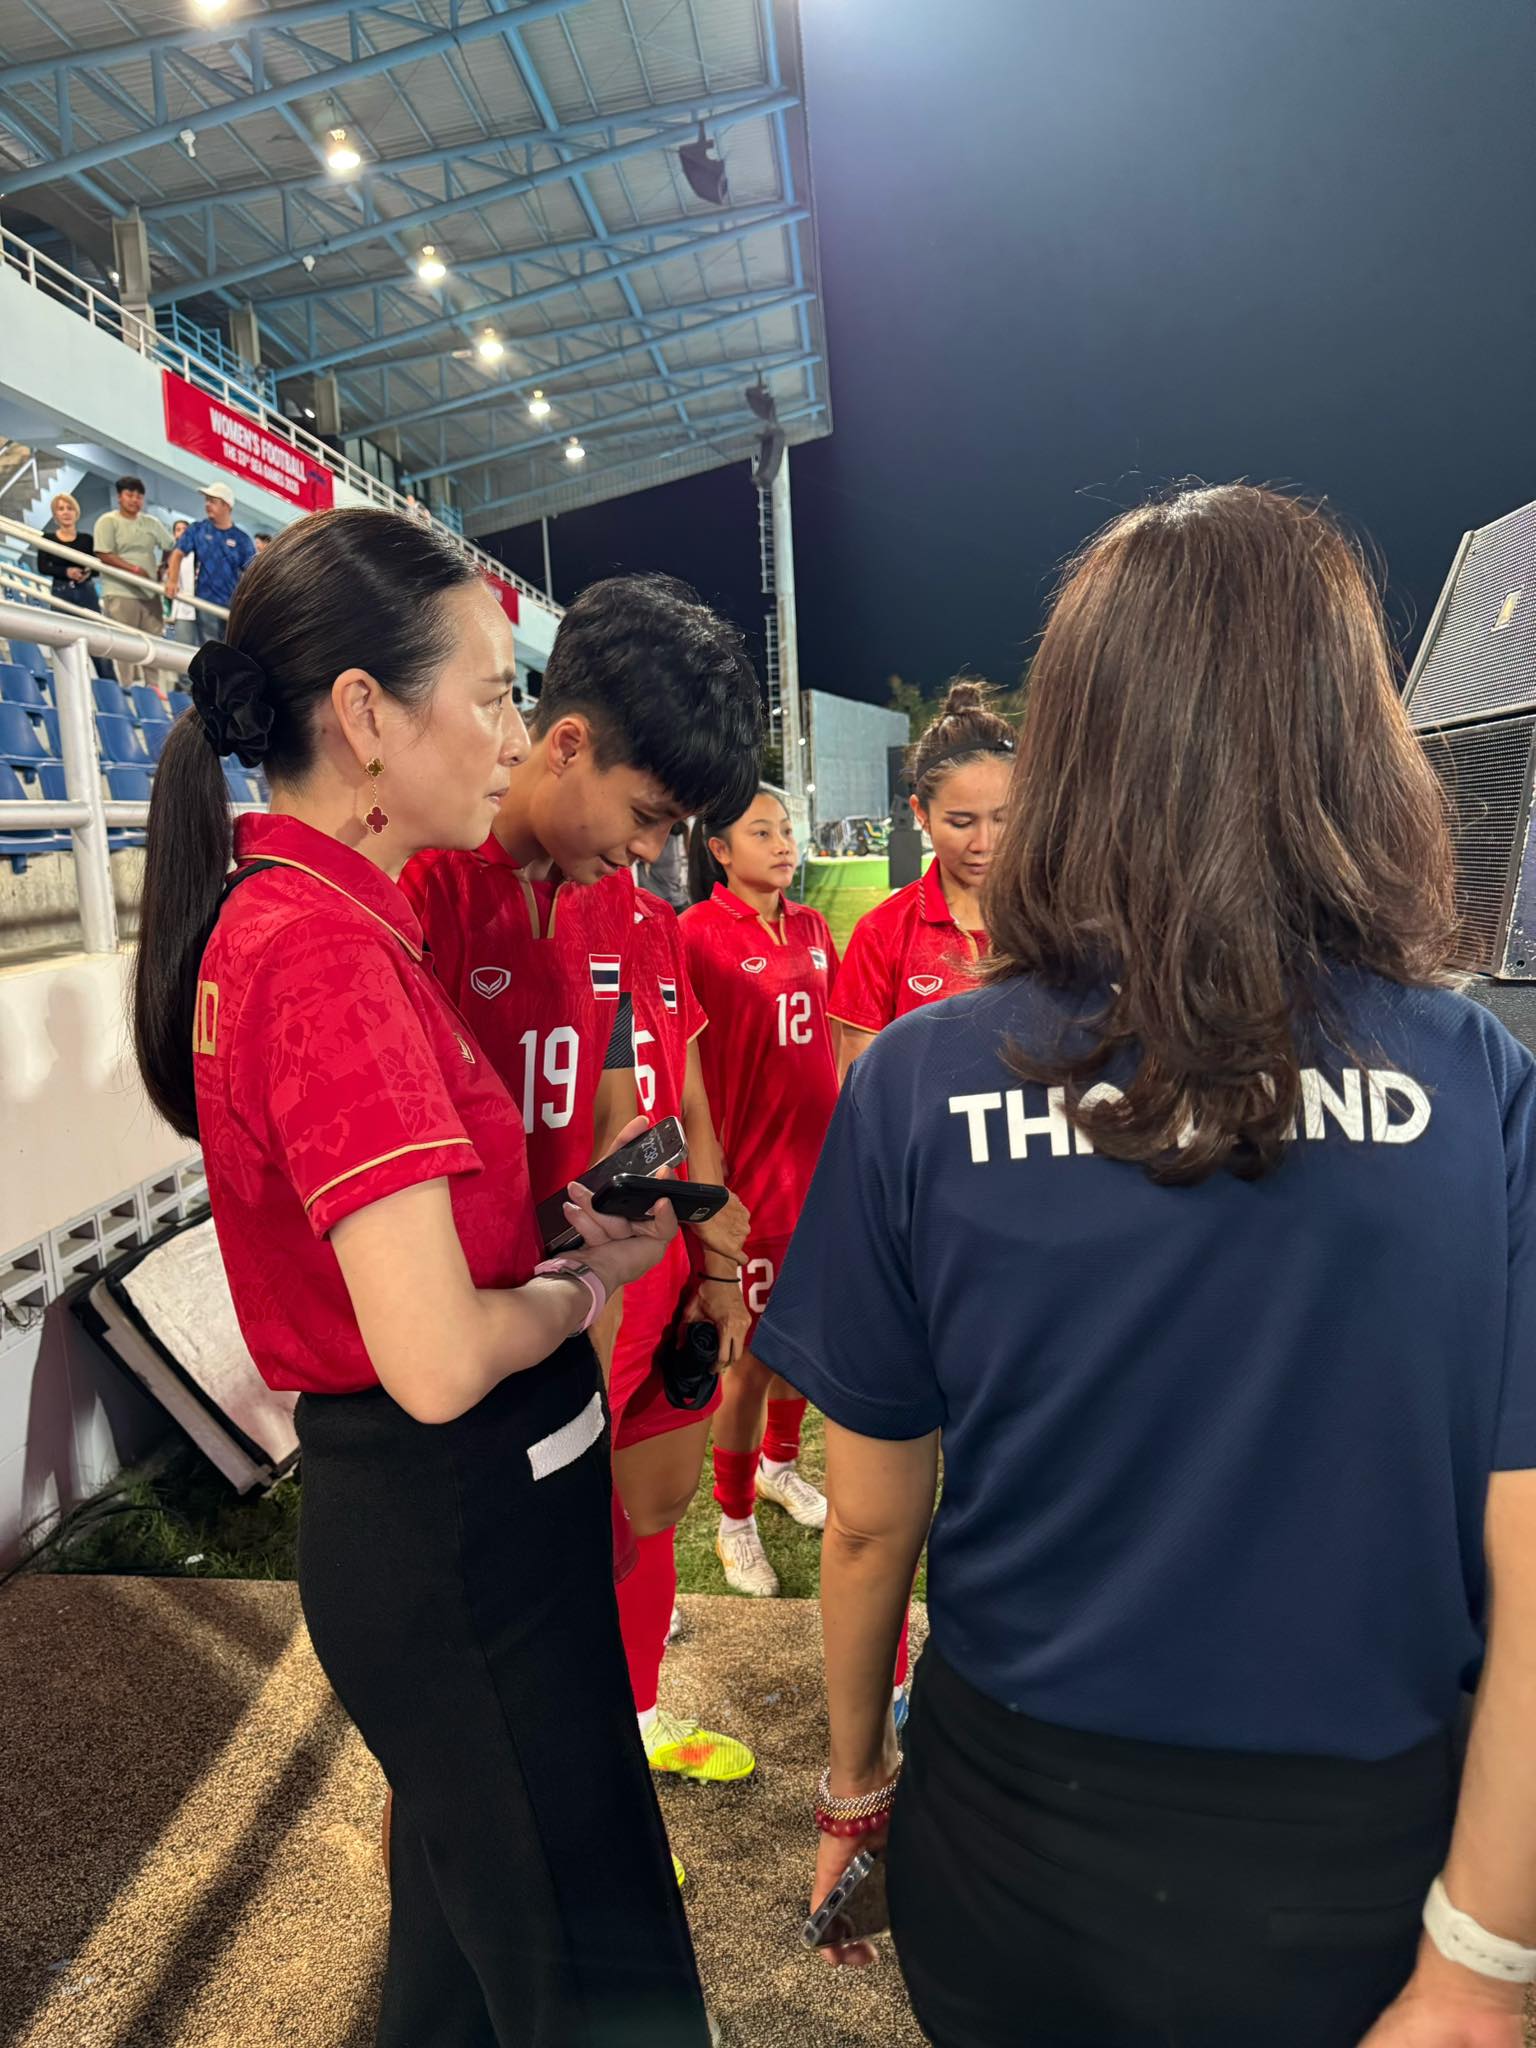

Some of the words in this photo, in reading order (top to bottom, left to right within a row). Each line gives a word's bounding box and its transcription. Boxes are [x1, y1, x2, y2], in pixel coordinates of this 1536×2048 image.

[210, 407, 261, 456] WOMEN'S
[262, 438, 307, 484] FOOTBALL
[776, 991, 813, 1047] 12
[518, 1025, 580, 1135] 19
[948, 1068, 1432, 1164] THND
